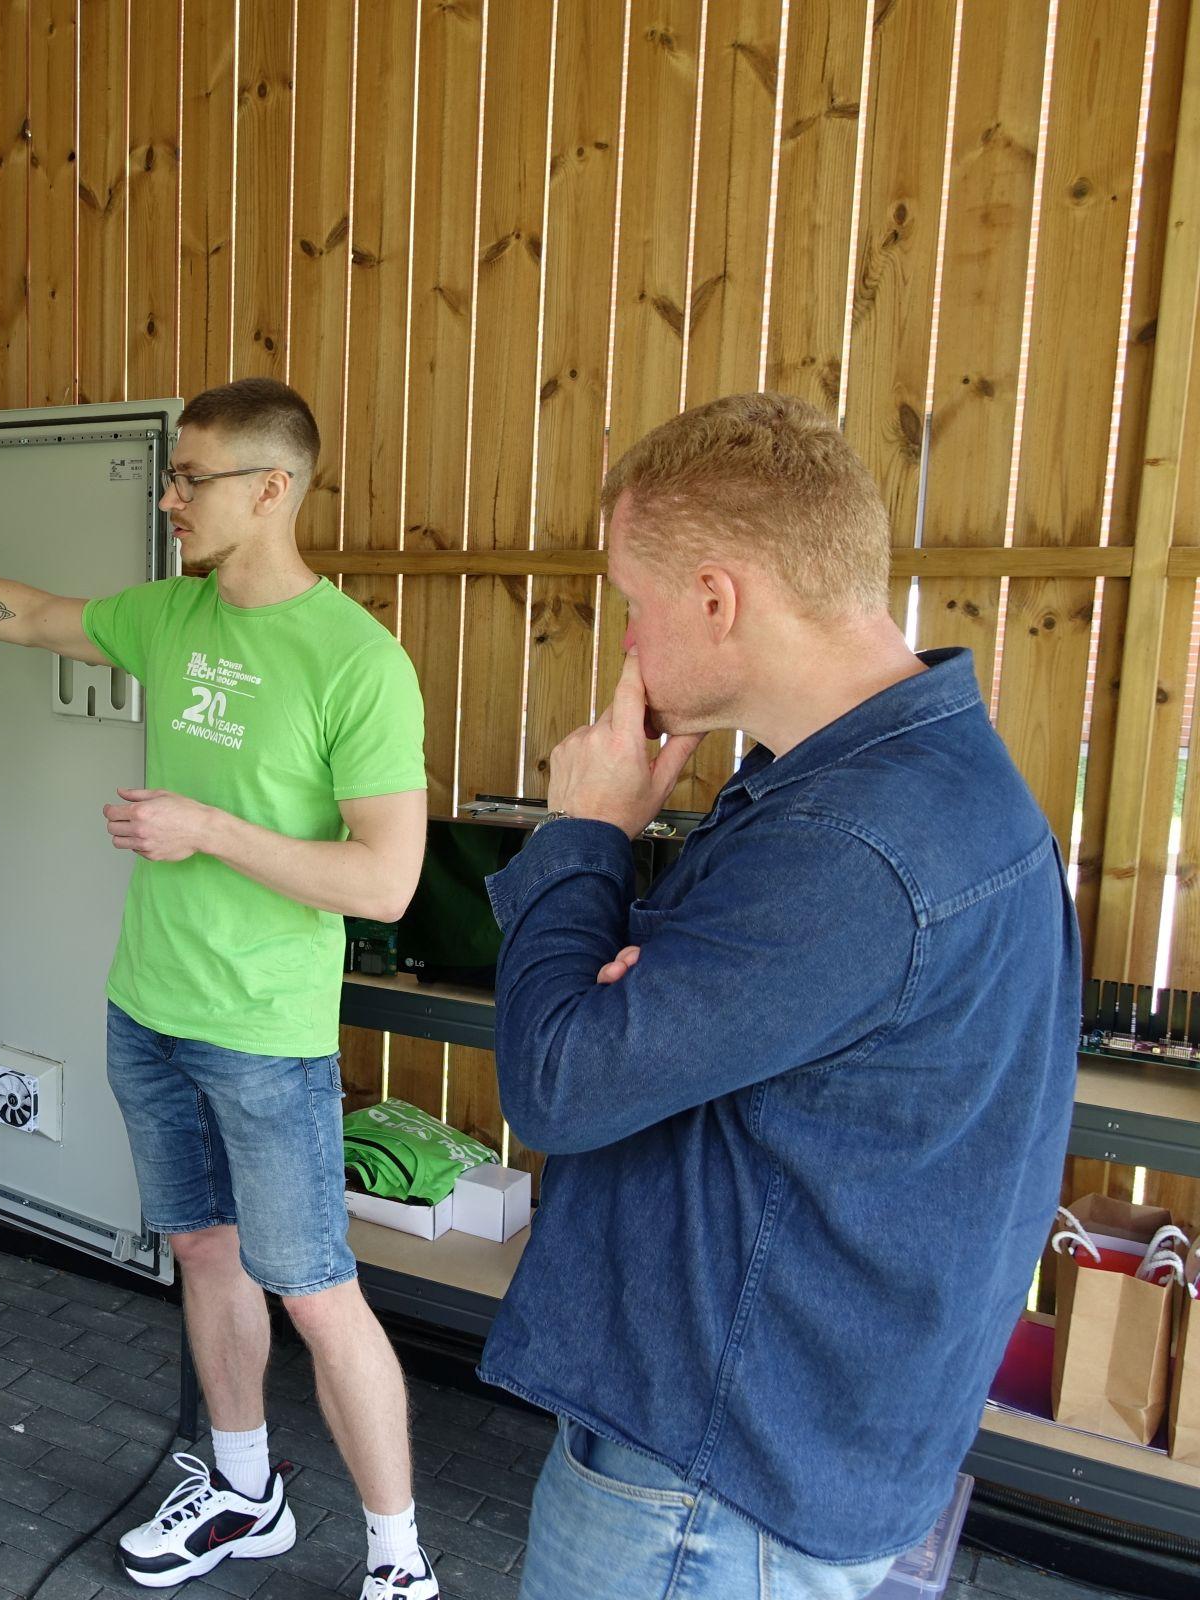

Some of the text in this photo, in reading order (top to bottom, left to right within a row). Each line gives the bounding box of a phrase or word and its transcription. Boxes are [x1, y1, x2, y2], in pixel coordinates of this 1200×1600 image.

[191, 652, 207, 666] TAL
[218, 658, 243, 671] POWER
[186, 662, 216, 681] TECH
[216, 667, 262, 685] ELECTRONICS
[182, 686, 245, 737] 20 YEARS
[171, 719, 243, 750] OF INNOVATION
[414, 960, 425, 968] LG
